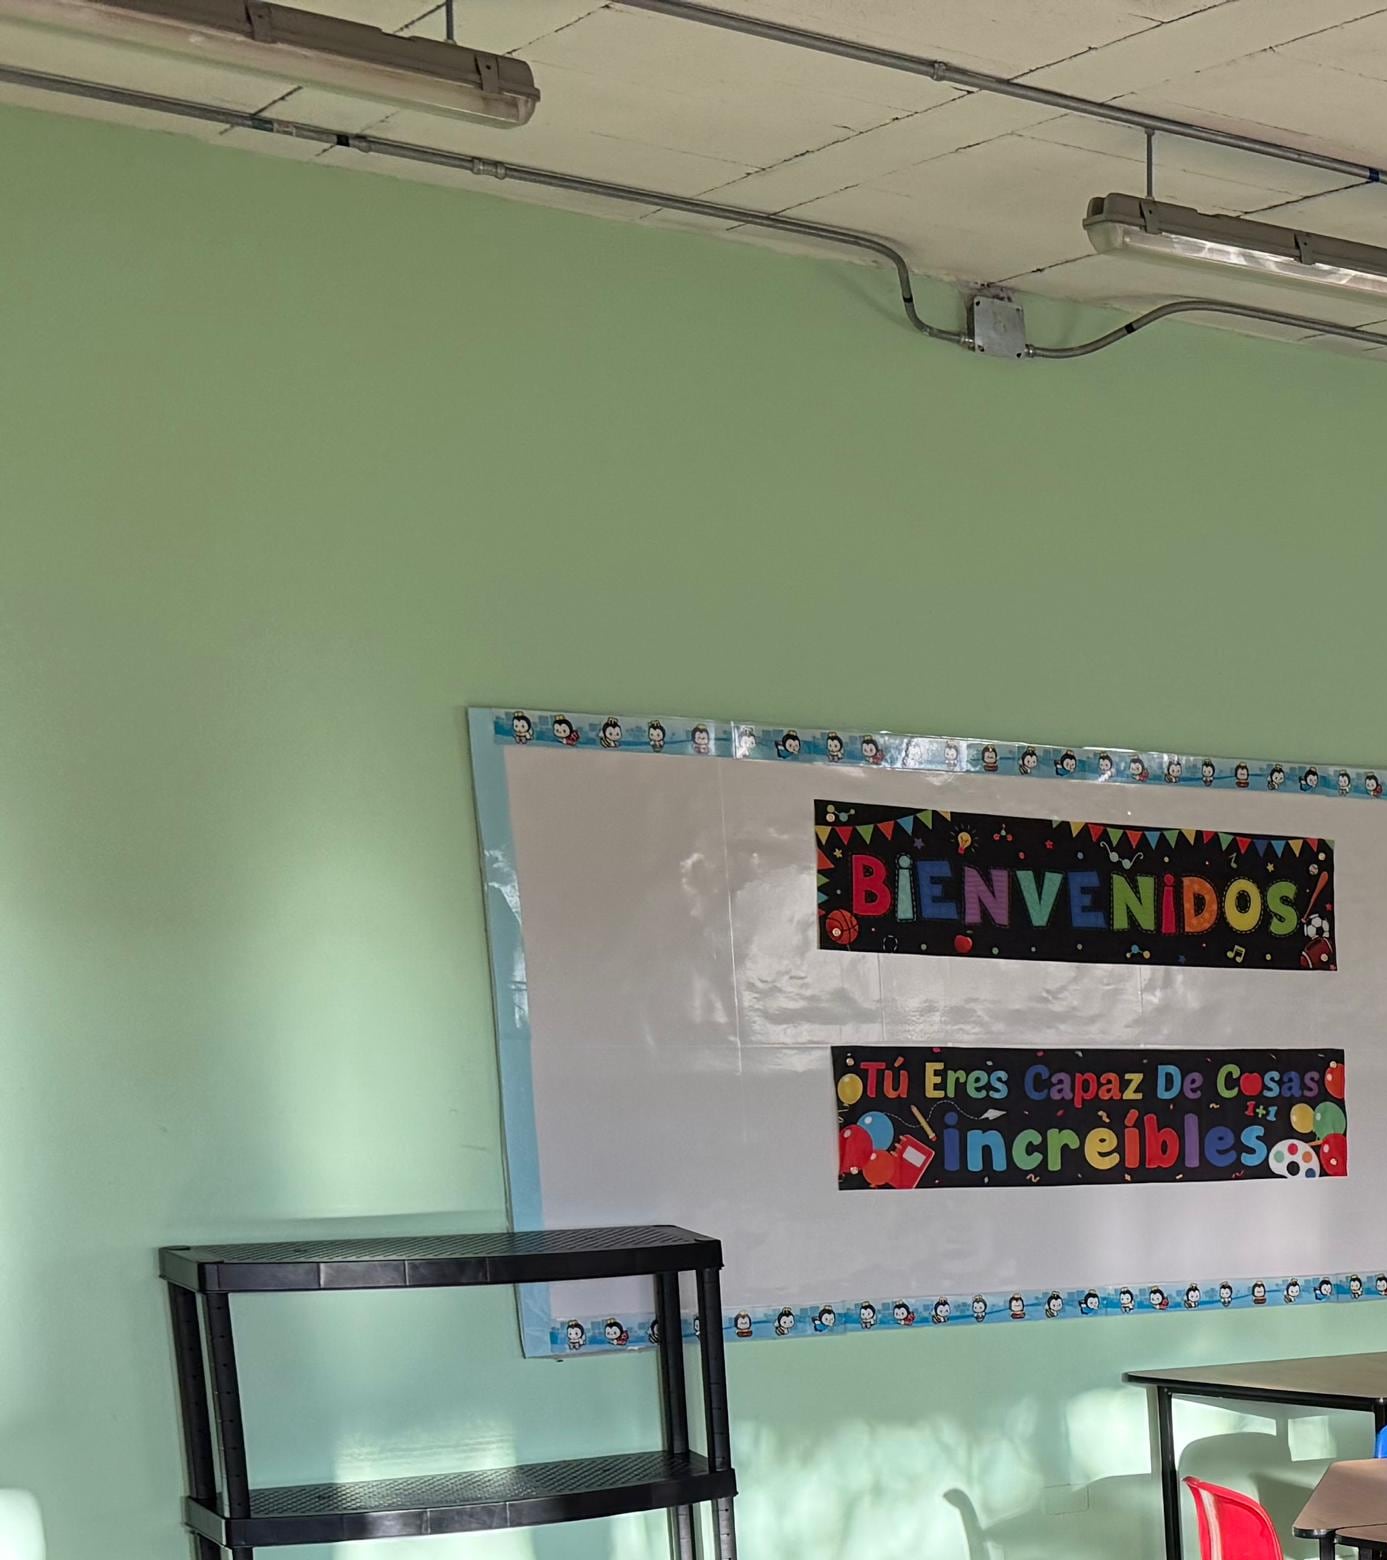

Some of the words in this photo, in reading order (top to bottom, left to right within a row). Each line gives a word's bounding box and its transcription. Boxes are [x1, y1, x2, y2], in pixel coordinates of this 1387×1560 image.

[860, 1056, 909, 1099] Tú
[925, 1062, 1009, 1100] Eres
[1024, 1064, 1144, 1108] Capaz
[1157, 1064, 1204, 1099] De
[1216, 1063, 1321, 1100] Cosas
[943, 1107, 1269, 1173] increíbles
